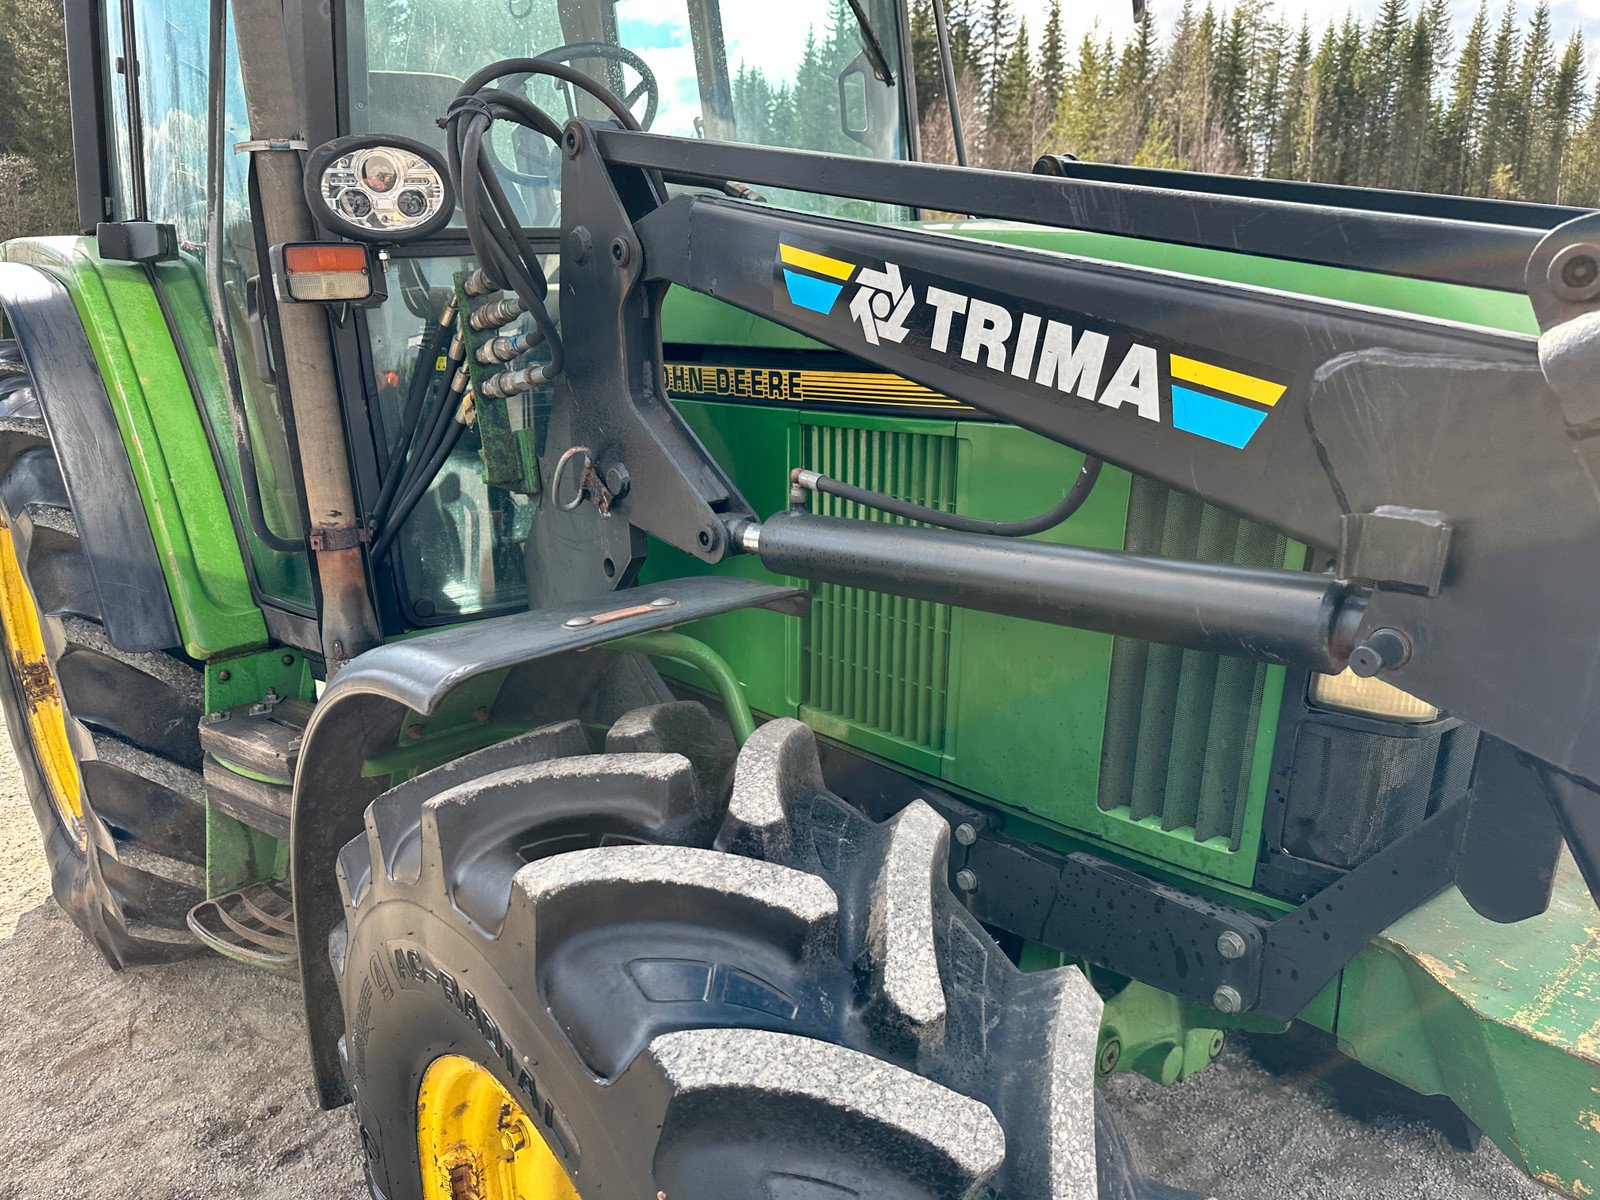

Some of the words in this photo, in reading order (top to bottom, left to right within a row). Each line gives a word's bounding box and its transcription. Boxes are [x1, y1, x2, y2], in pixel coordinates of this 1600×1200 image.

[663, 365, 704, 393] HN
[716, 368, 803, 401] DEERE
[926, 285, 1160, 423] TRIMA
